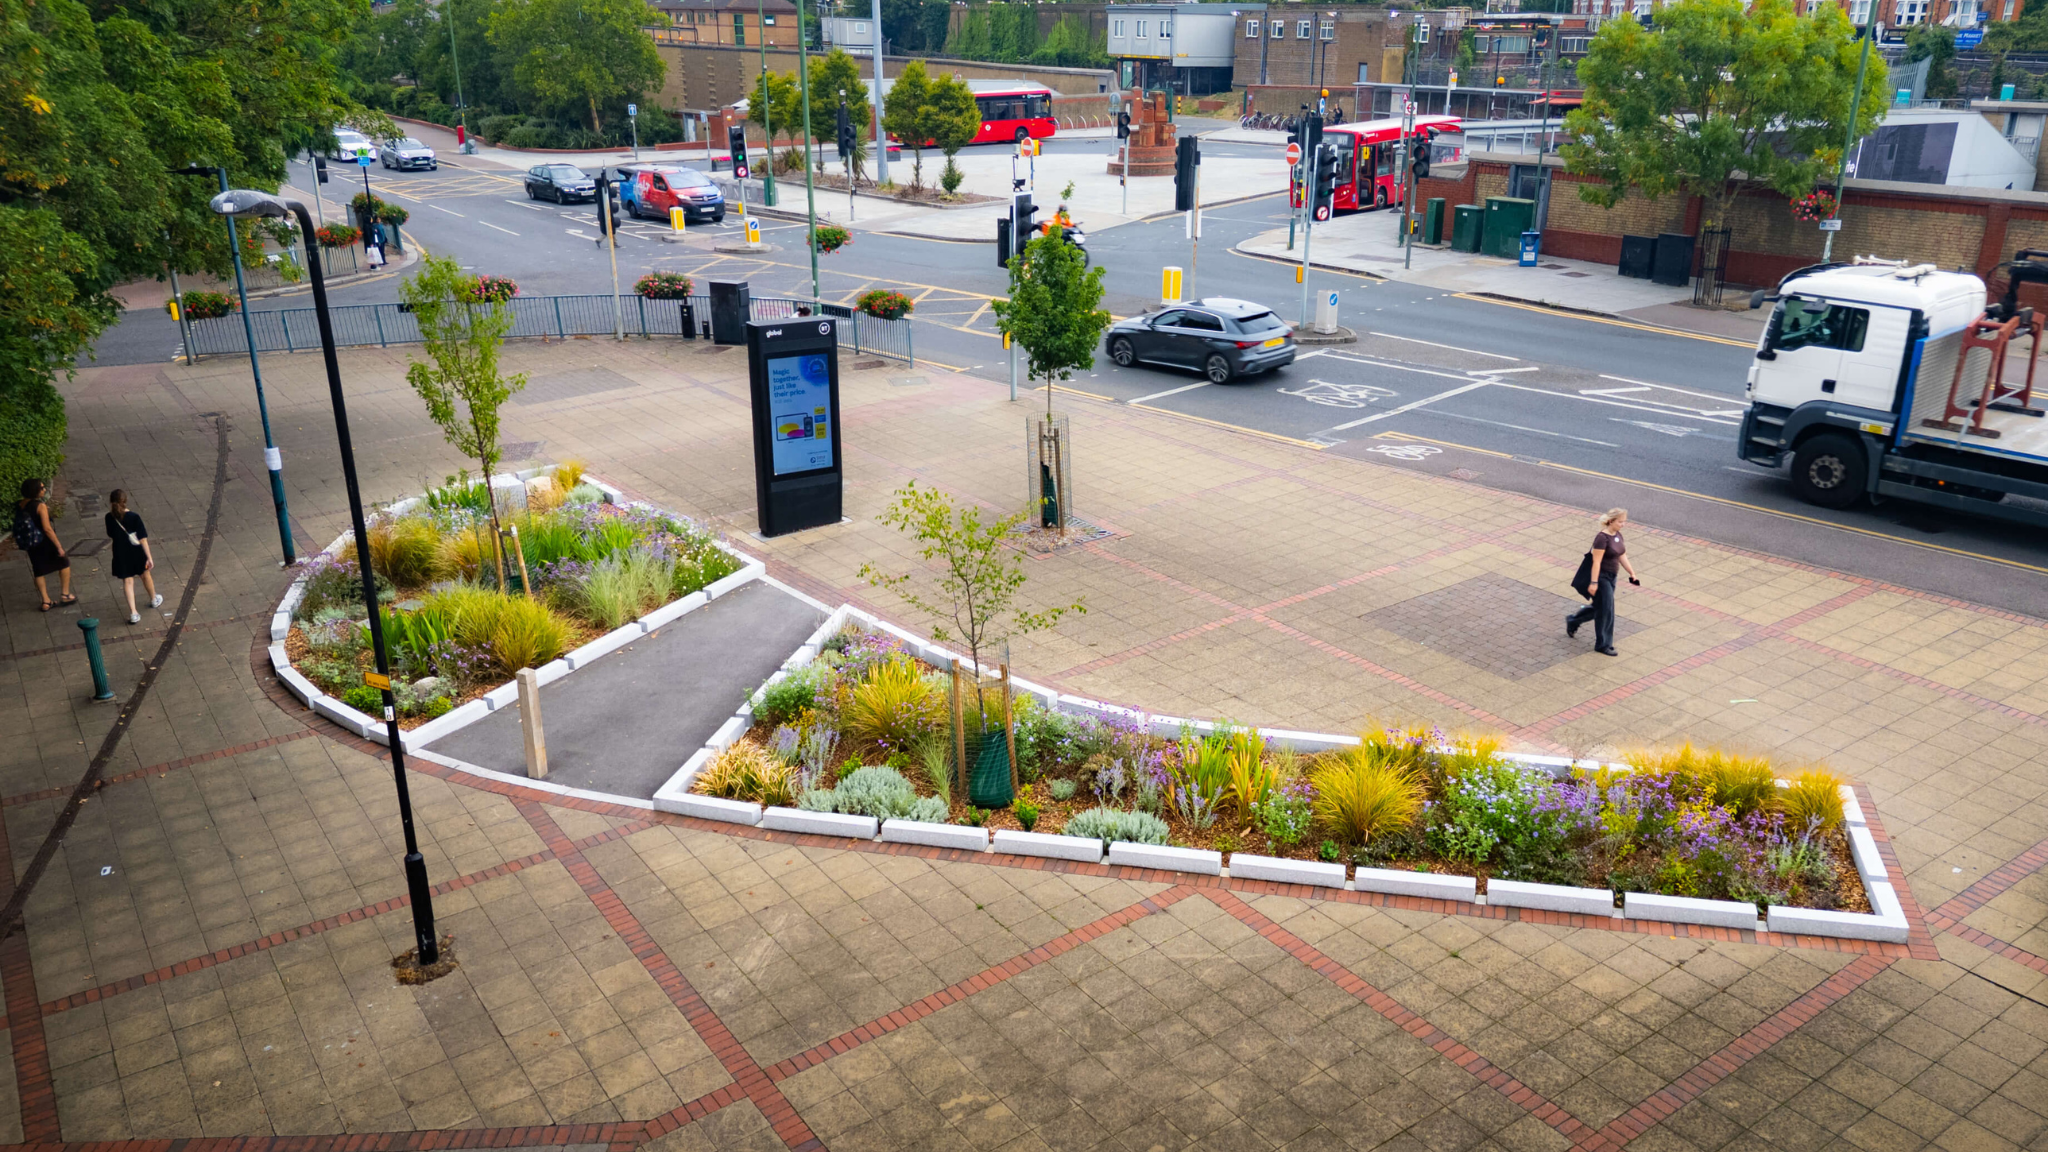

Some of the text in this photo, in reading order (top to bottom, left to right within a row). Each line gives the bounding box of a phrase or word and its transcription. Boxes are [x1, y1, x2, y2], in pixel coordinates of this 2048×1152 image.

[766, 329, 782, 338] global
[772, 368, 790, 376] Magic
[773, 384, 785, 392] just
[774, 390, 789, 398] their
